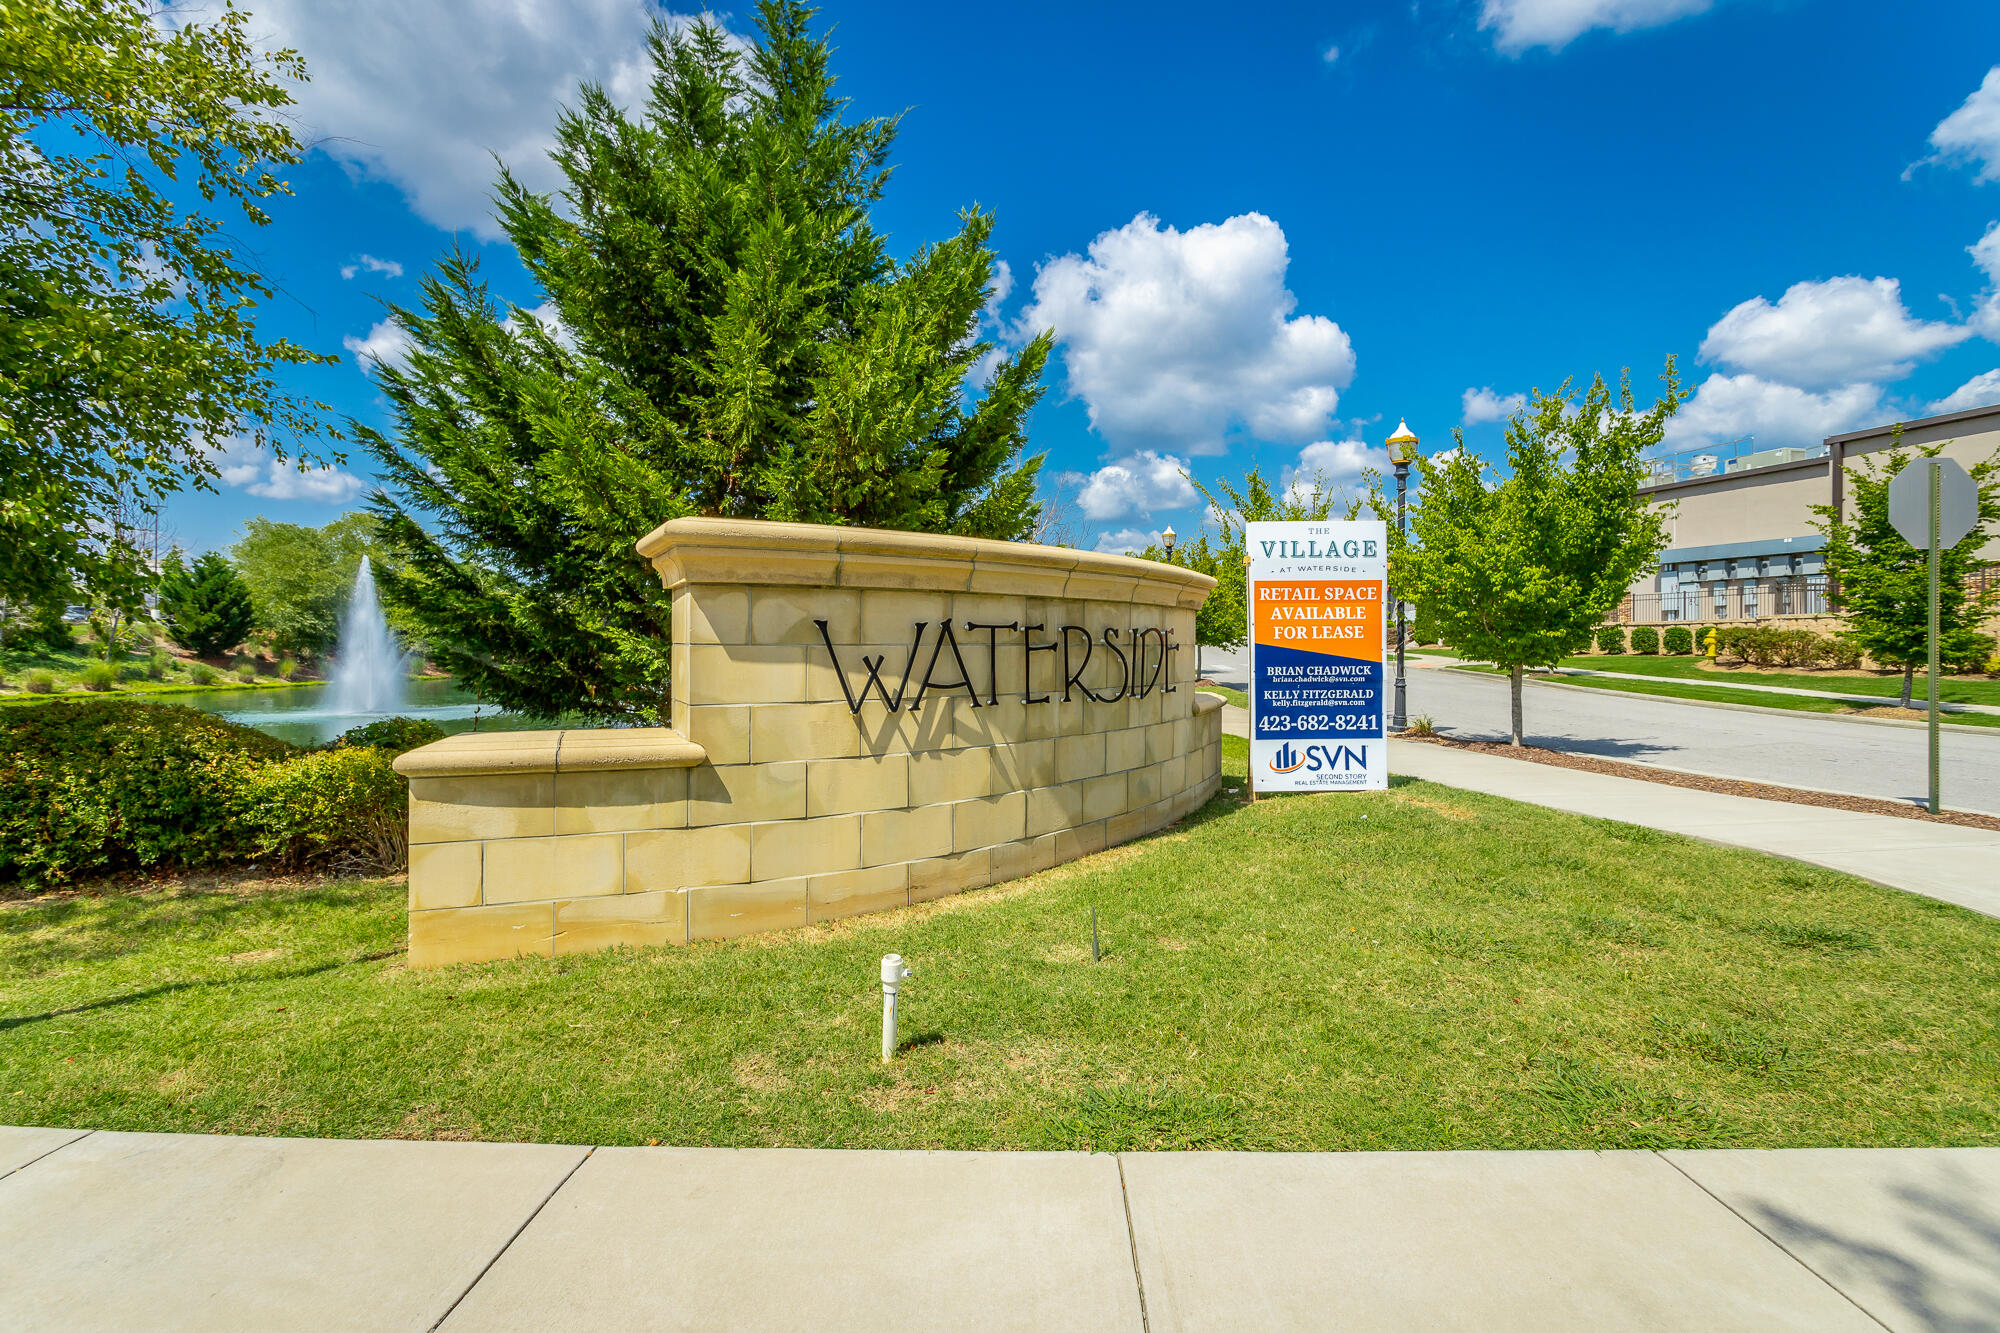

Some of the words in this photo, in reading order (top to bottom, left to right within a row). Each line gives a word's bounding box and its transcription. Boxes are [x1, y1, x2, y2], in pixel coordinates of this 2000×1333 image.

[1260, 540, 1377, 558] VILLAGE
[1298, 565, 1357, 573] WATERSIDE
[1259, 588, 1320, 600] RETAIL
[1324, 587, 1377, 600] SPACE
[1270, 607, 1366, 620] AVAILABLE
[1273, 626, 1307, 639] FOR
[1312, 626, 1364, 639] LEASE
[813, 618, 1179, 715] WATERSIDE
[1267, 666, 1304, 676] BRIAN
[1307, 666, 1371, 675] CHADWICK
[1264, 690, 1299, 700] KELLY
[1303, 689, 1374, 699] FITZGERALD
[1272, 699, 1365, 708] kelly.fitzgerald@svn.com
[1259, 715, 1378, 731] 423-682-8241
[1306, 745, 1367, 771] SVN
